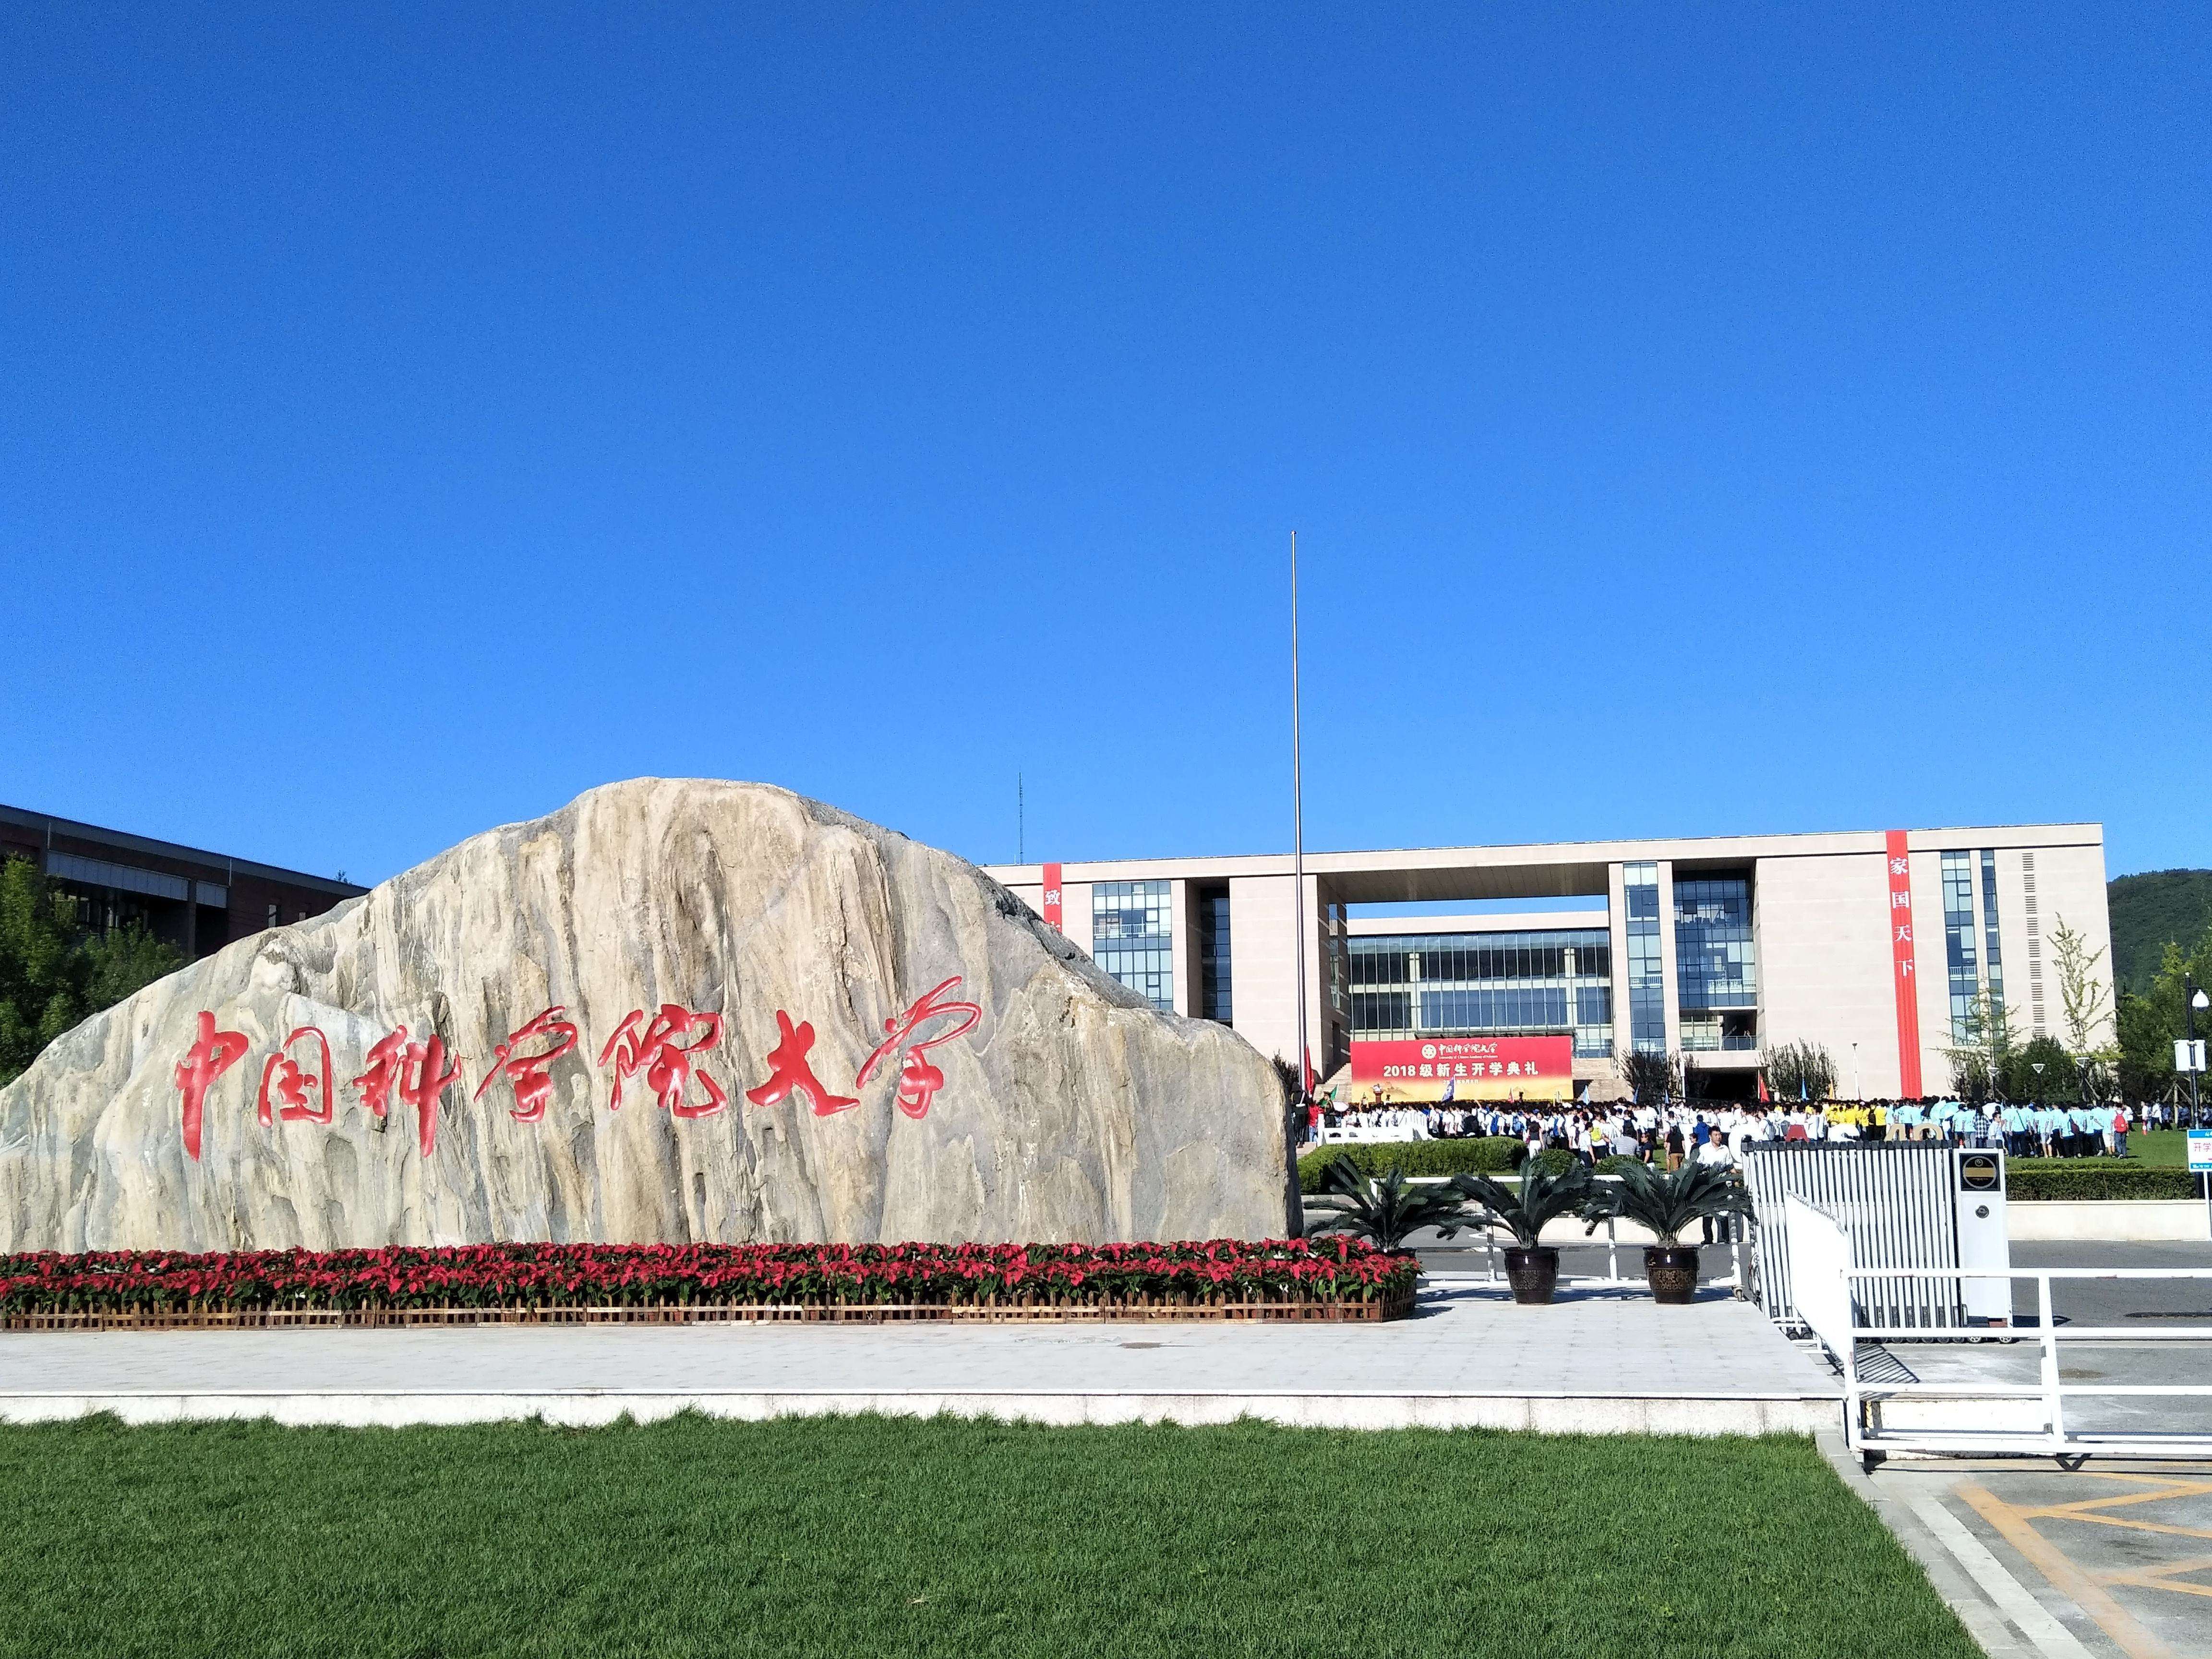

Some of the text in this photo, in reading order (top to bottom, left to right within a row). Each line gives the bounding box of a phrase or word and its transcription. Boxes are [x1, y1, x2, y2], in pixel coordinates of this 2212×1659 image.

[1889, 857, 1913, 977] 家国天下
[175, 976, 981, 1161] 中国科学院大学
[1383, 1061, 1539, 1077] 2018级新生开学典礼
[1439, 1042, 1498, 1056] 中国科学院大学
